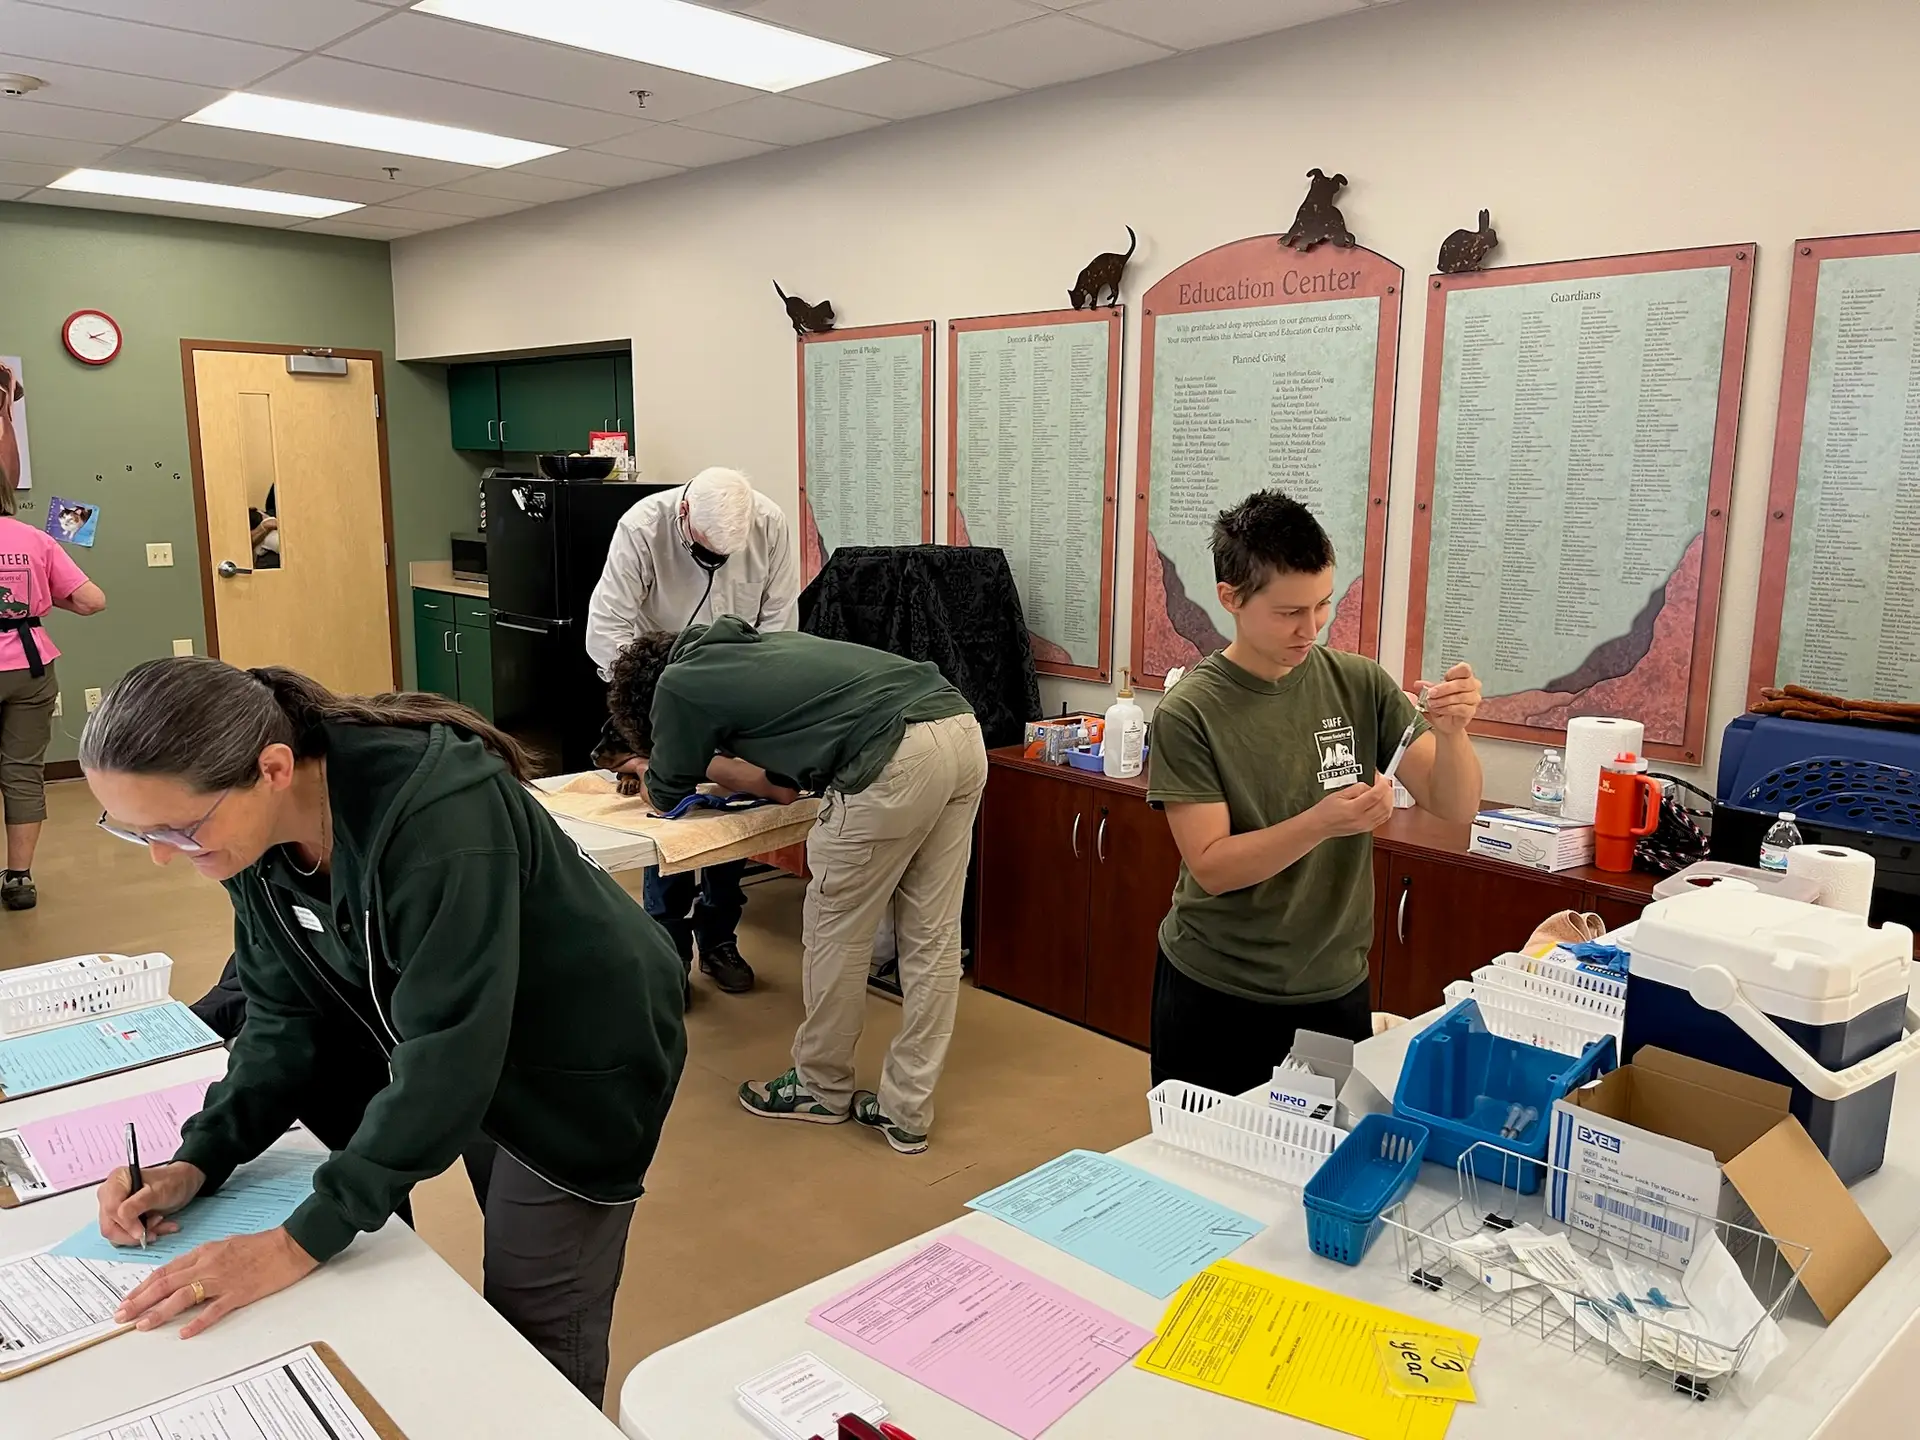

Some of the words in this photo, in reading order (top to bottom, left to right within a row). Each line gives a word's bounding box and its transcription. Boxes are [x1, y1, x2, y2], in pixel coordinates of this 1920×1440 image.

[1179, 278, 1274, 306] Education
[1283, 268, 1362, 296] Center
[1550, 290, 1602, 303] Guardians
[1191, 323, 1215, 332] gratitude
[1242, 319, 1277, 329] appreciation
[1281, 327, 1312, 336] Education
[1336, 324, 1362, 333] possible.
[1007, 334, 1026, 343] Donors
[1034, 333, 1054, 343] Pledges
[864, 346, 881, 354] Pledges
[1232, 354, 1261, 364] Planned
[1262, 353, 1286, 364] Giving
[1322, 717, 1342, 728] STAFF
[1321, 767, 1358, 779] SEDONA
[1585, 965, 1621, 977] Nitrile
[1270, 1091, 1306, 1107] NIPRO
[1579, 1127, 1618, 1152] EXEL
[1635, 1176, 1649, 1185] Lock
[1580, 1219, 1594, 1230] 100
[1389, 1340, 1428, 1383] year
[1431, 1356, 1464, 1372] 3
